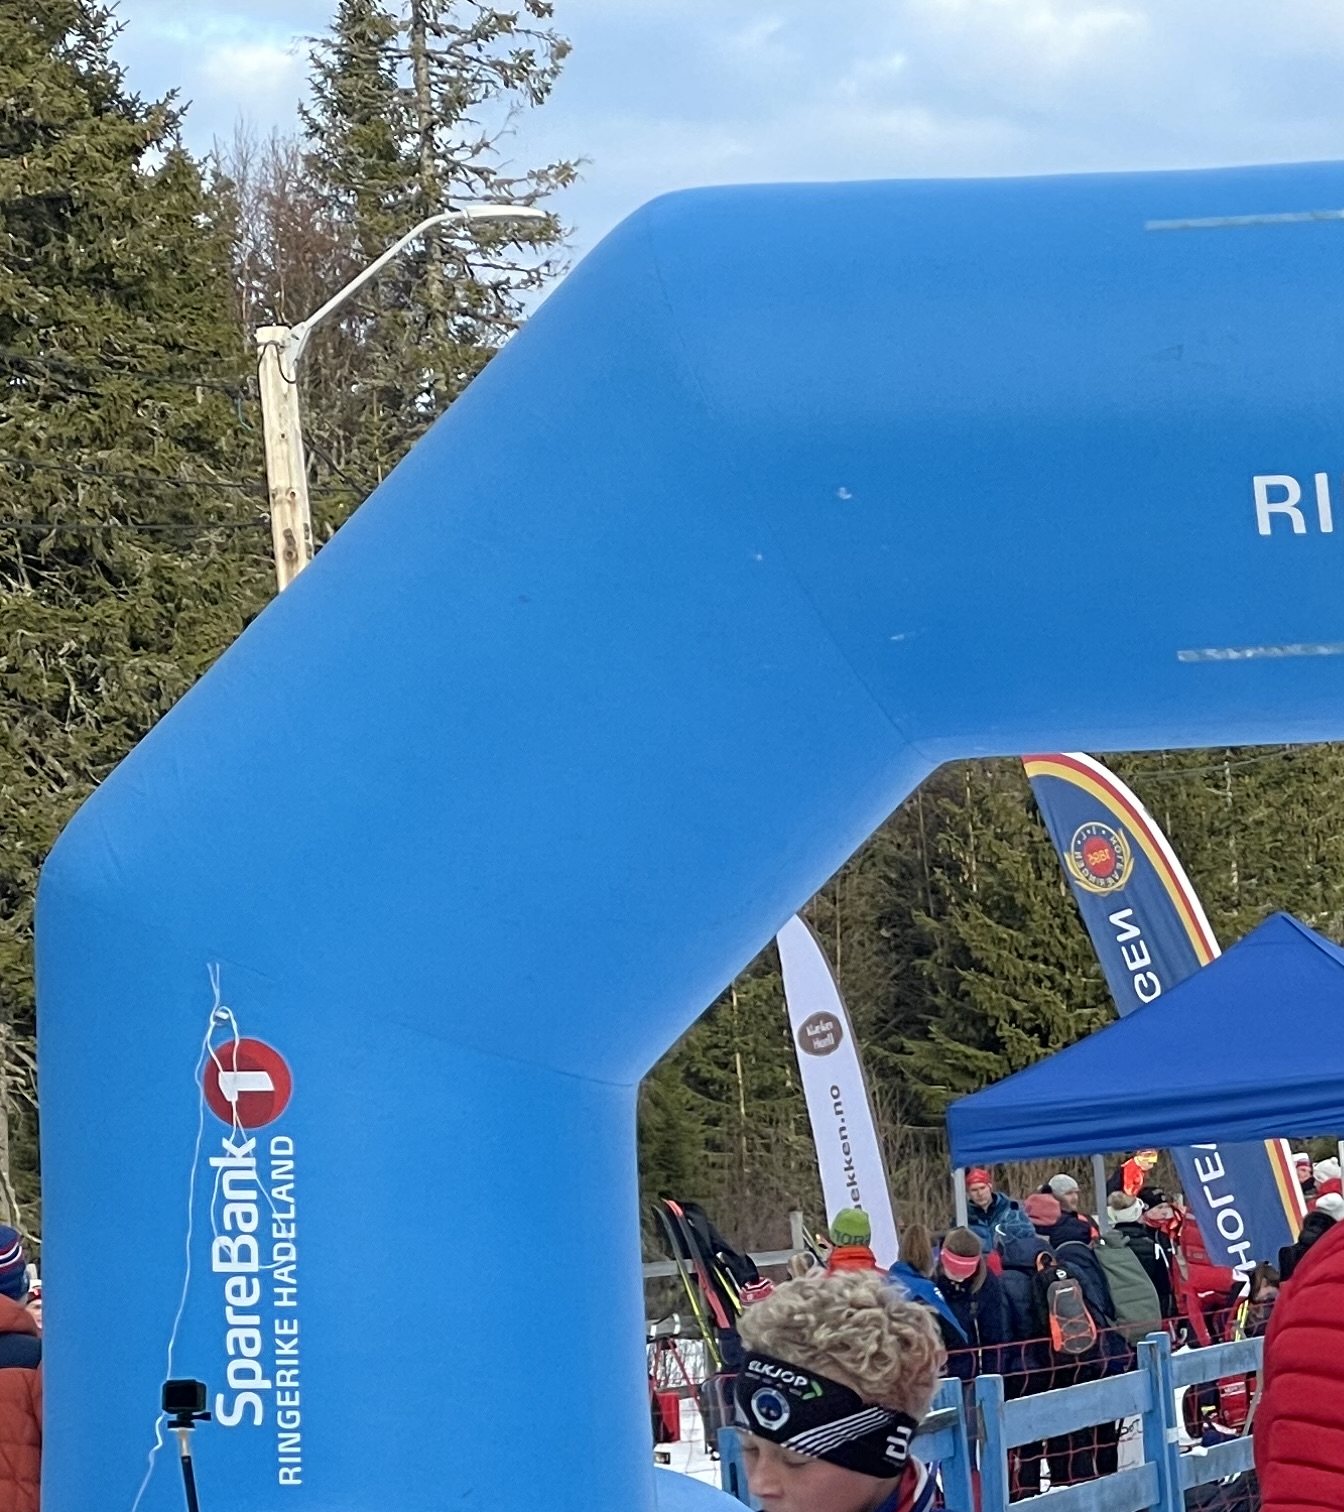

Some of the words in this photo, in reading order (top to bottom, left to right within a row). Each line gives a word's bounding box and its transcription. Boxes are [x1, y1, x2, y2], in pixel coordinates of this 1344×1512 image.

[218, 1070, 275, 1101] 1
[829, 1084, 862, 1210] ekken.no
[209, 1136, 271, 1427] SpareBank
[269, 1135, 298, 1306] HADELAND
[271, 1318, 303, 1486] RINGERIKE
